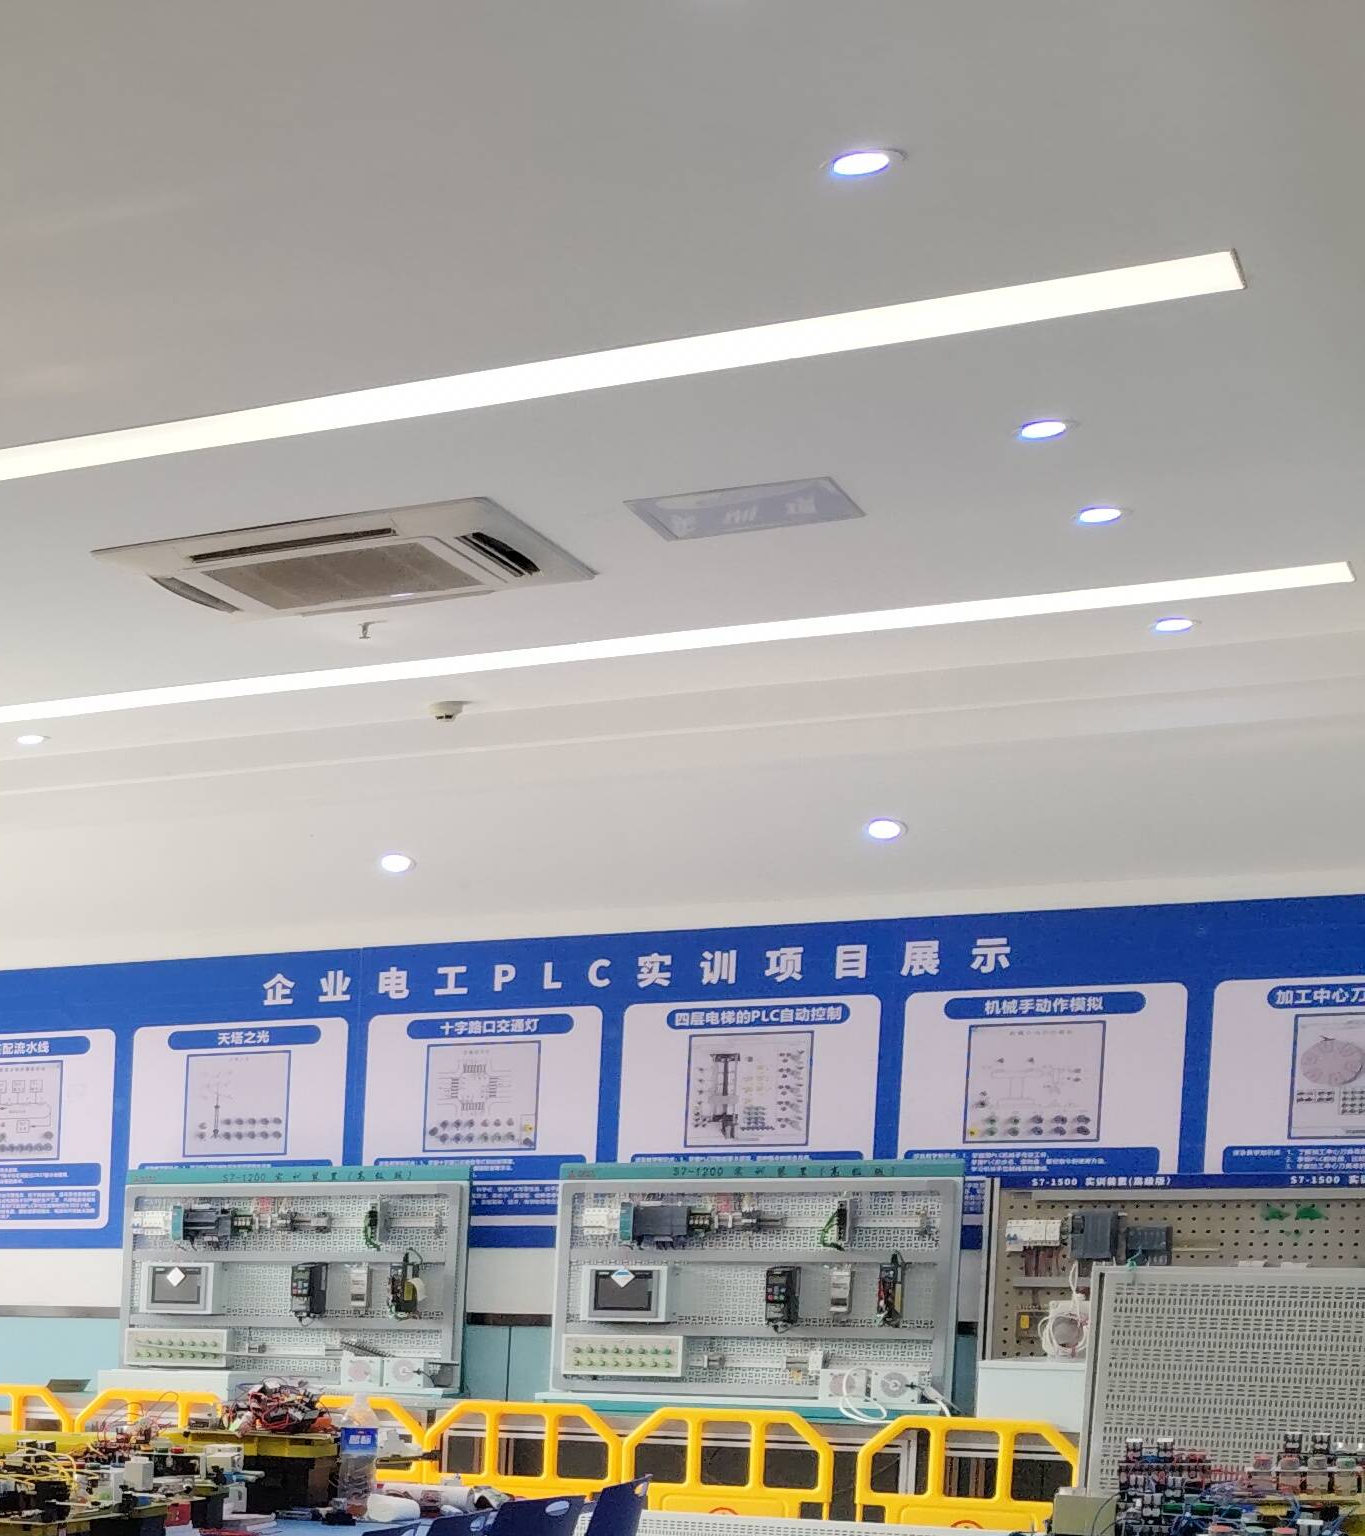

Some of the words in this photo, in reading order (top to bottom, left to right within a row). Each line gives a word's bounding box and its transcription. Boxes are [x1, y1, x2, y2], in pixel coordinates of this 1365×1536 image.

[262, 938, 1011, 1006] 企业电工PLC实训项目展示
[984, 996, 1104, 1015] 机械手动作模拟
[674, 1006, 843, 1026] 四层电梯的PLC自动控制
[440, 1018, 539, 1035] 十字路口交通灯
[217, 1030, 270, 1045] 天塔之光
[222, 1173, 266, 1182] S7-1200
[672, 1166, 723, 1177] S7-1200
[1031, 1177, 1078, 1187] S7-1500
[1290, 1175, 1341, 1185] S7-1500
